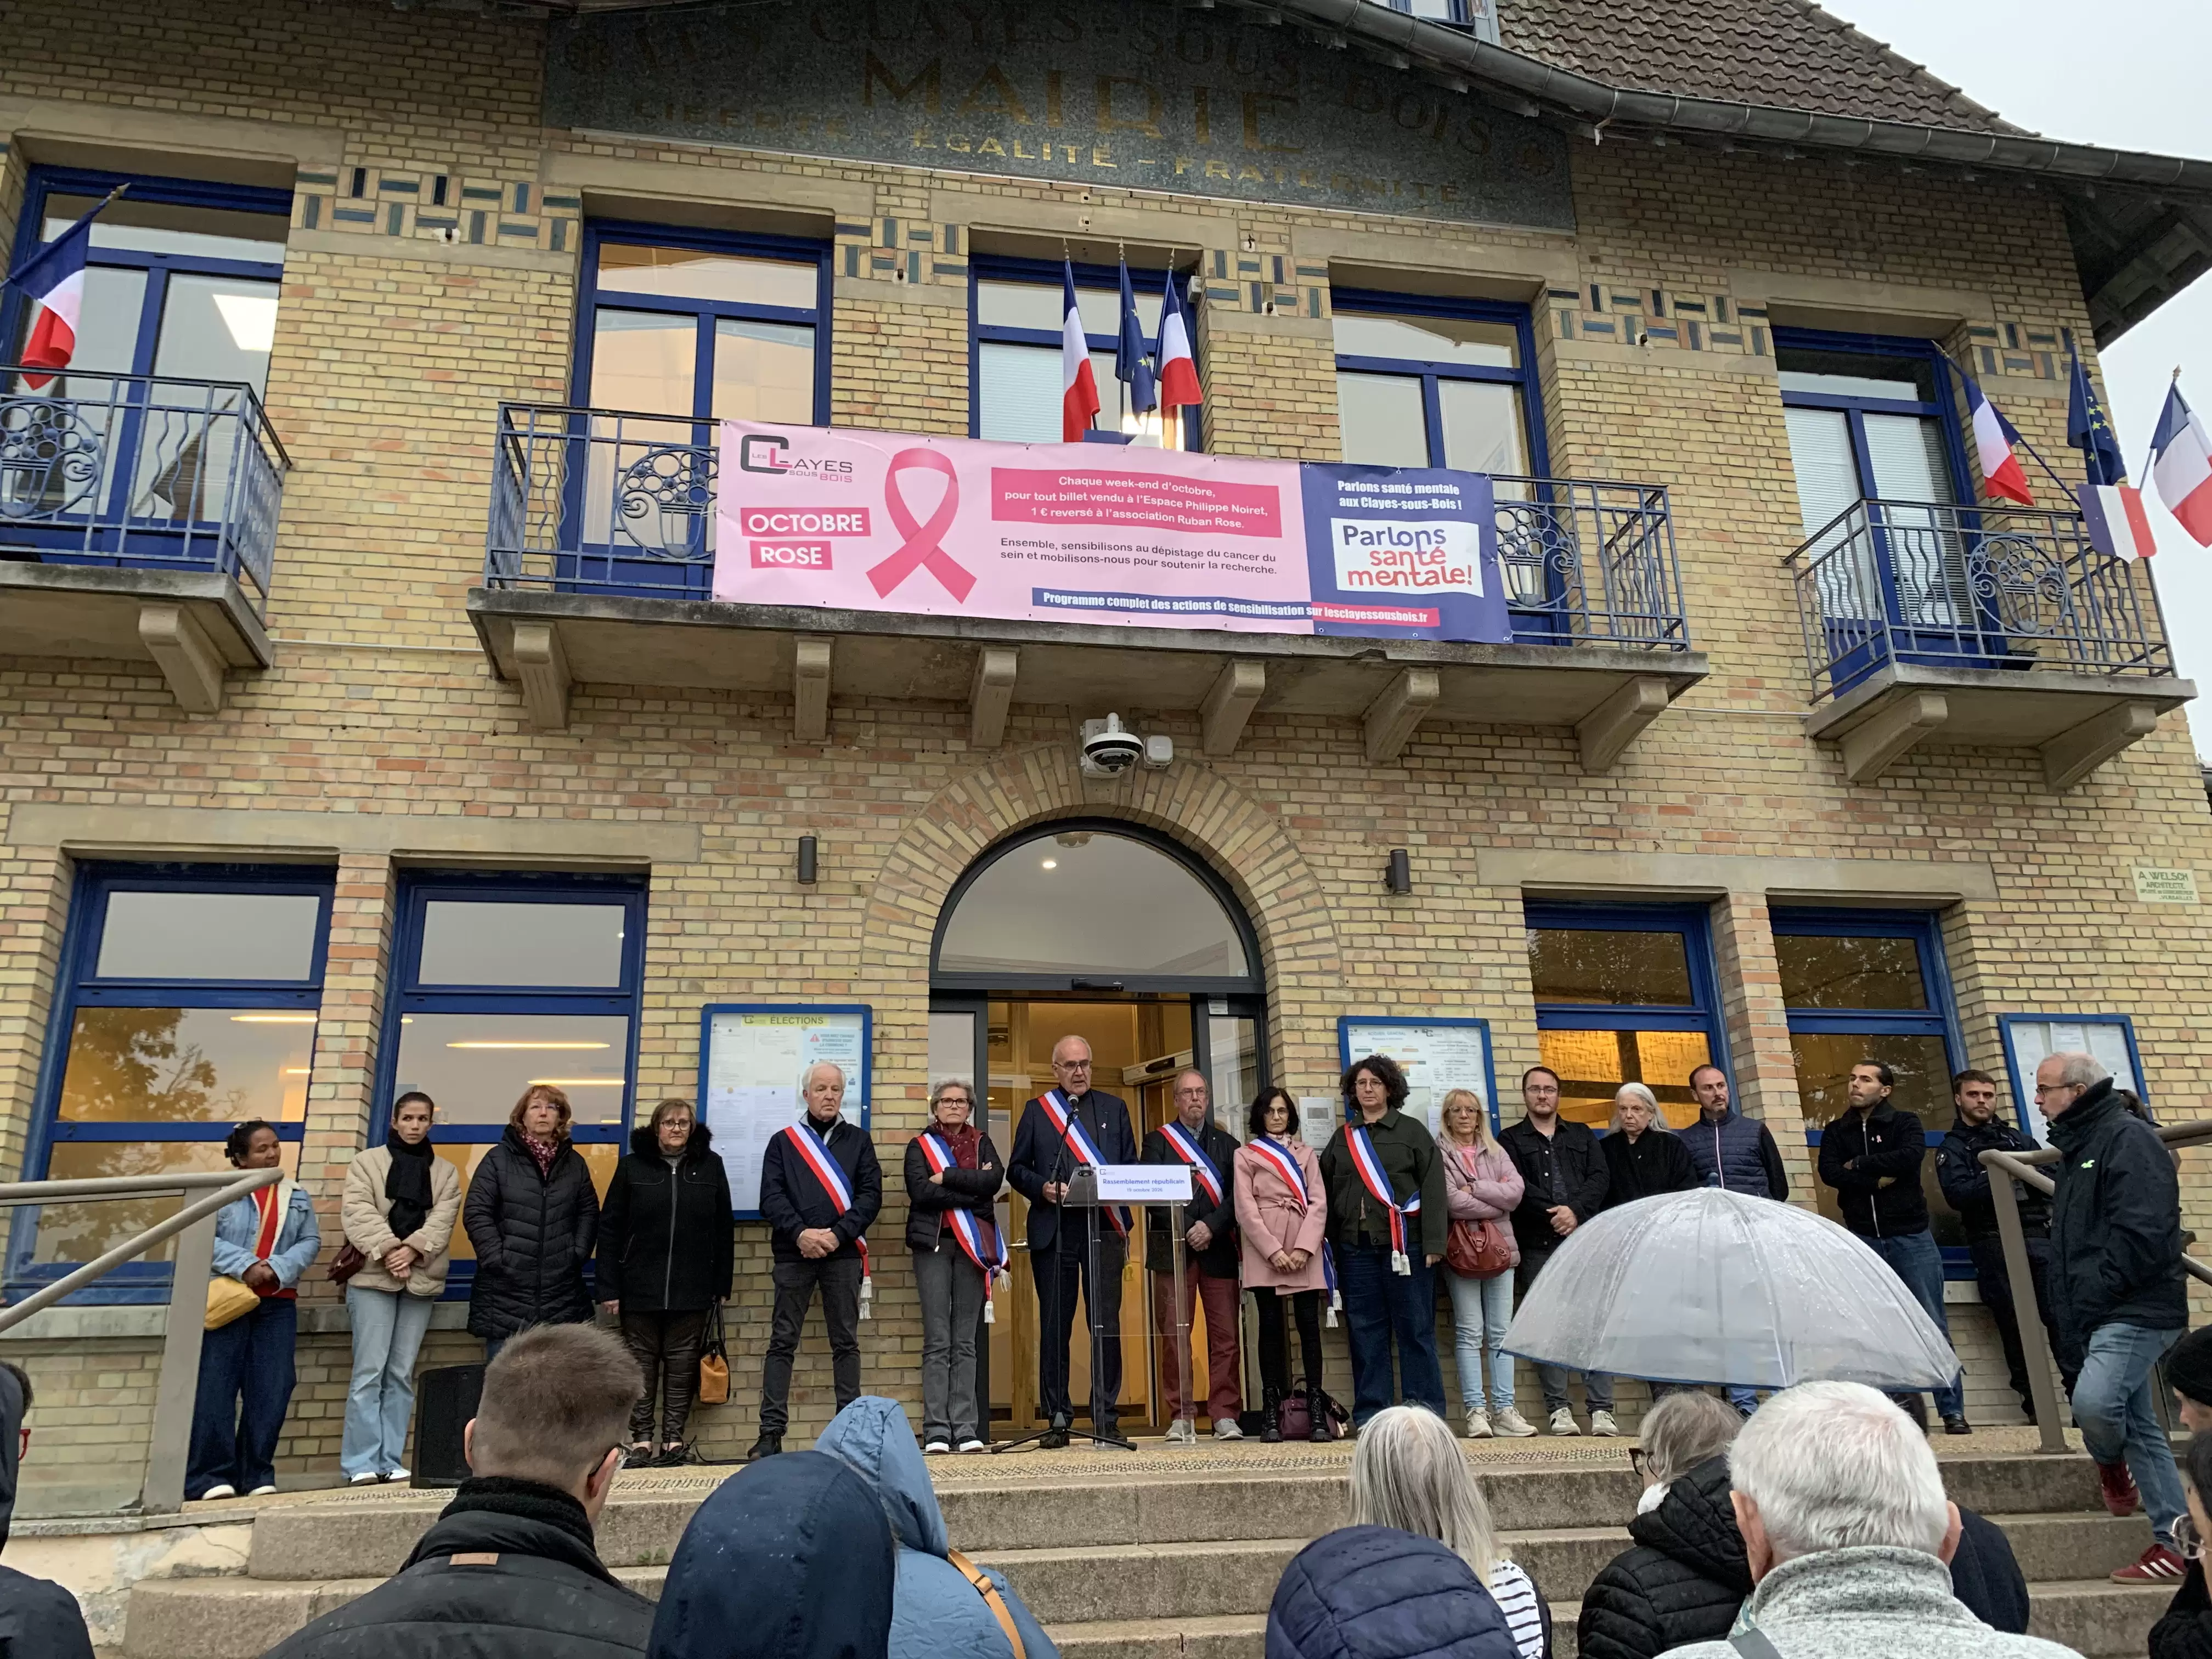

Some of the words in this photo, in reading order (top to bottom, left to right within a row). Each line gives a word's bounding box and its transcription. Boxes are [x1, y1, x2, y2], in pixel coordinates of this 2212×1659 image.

[860, 49, 1306, 155] MAIRIE
[820, 473, 852, 483] BOIS
[1059, 476, 1102, 487] Chaque
[1105, 478, 1159, 490] week-end
[1162, 481, 1215, 498] d'octobre,
[1338, 481, 1379, 493] Parlons
[1381, 483, 1412, 494] santé
[1414, 483, 1459, 495] mentale
[1005, 492, 1031, 502] pour
[1034, 492, 1057, 501] tout
[1059, 492, 1087, 502] billet
[1090, 493, 1125, 504] vendu
[1127, 495, 1134, 503] à
[1137, 494, 1183, 509] l'Espace
[1186, 500, 1228, 515] Philippe
[1232, 503, 1268, 516] Noiret,
[1340, 499, 1359, 507] aux
[1361, 498, 1456, 510] Clayes-sous-Bois
[1458, 500, 1462, 510] !
[748, 514, 863, 532] OCTOBRE
[1031, 507, 1036, 516] 1
[1040, 508, 1048, 516] €
[1051, 507, 1093, 517] reversé
[1096, 508, 1103, 517] à
[1106, 509, 1175, 522] l'association
[1177, 516, 1212, 526] Ruban
[1215, 517, 1244, 528] Rose.
[1343, 525, 1446, 546] Parlons
[760, 546, 822, 565] ROSE
[1001, 538, 1058, 550] Ensemble,
[1062, 541, 1132, 552] sensibilisons
[1152, 546, 1204, 558] dépistage
[1207, 549, 1220, 557] du
[1223, 551, 1259, 560] cancer
[1262, 554, 1276, 562] du
[1370, 546, 1446, 566] santé
[1001, 551, 1024, 560] sein
[1027, 552, 1037, 560] et
[1041, 552, 1130, 564] mobilisons-nous
[1134, 558, 1158, 567] pour
[1161, 560, 1205, 569] soutenir
[1221, 562, 1276, 574] recherche.
[1348, 565, 1472, 586] mentale!
[1043, 592, 1104, 607] Programme
[1107, 596, 1149, 610] complet
[1152, 599, 1170, 610] des
[1172, 599, 1212, 611] actions
[1214, 600, 1226, 611] de
[1228, 601, 1304, 616] sensibilisation
[1306, 607, 1322, 616] sur
[1324, 607, 1427, 622] lesclayessousbois.fr
[770, 1014, 823, 1024] ÉLECTIONS
